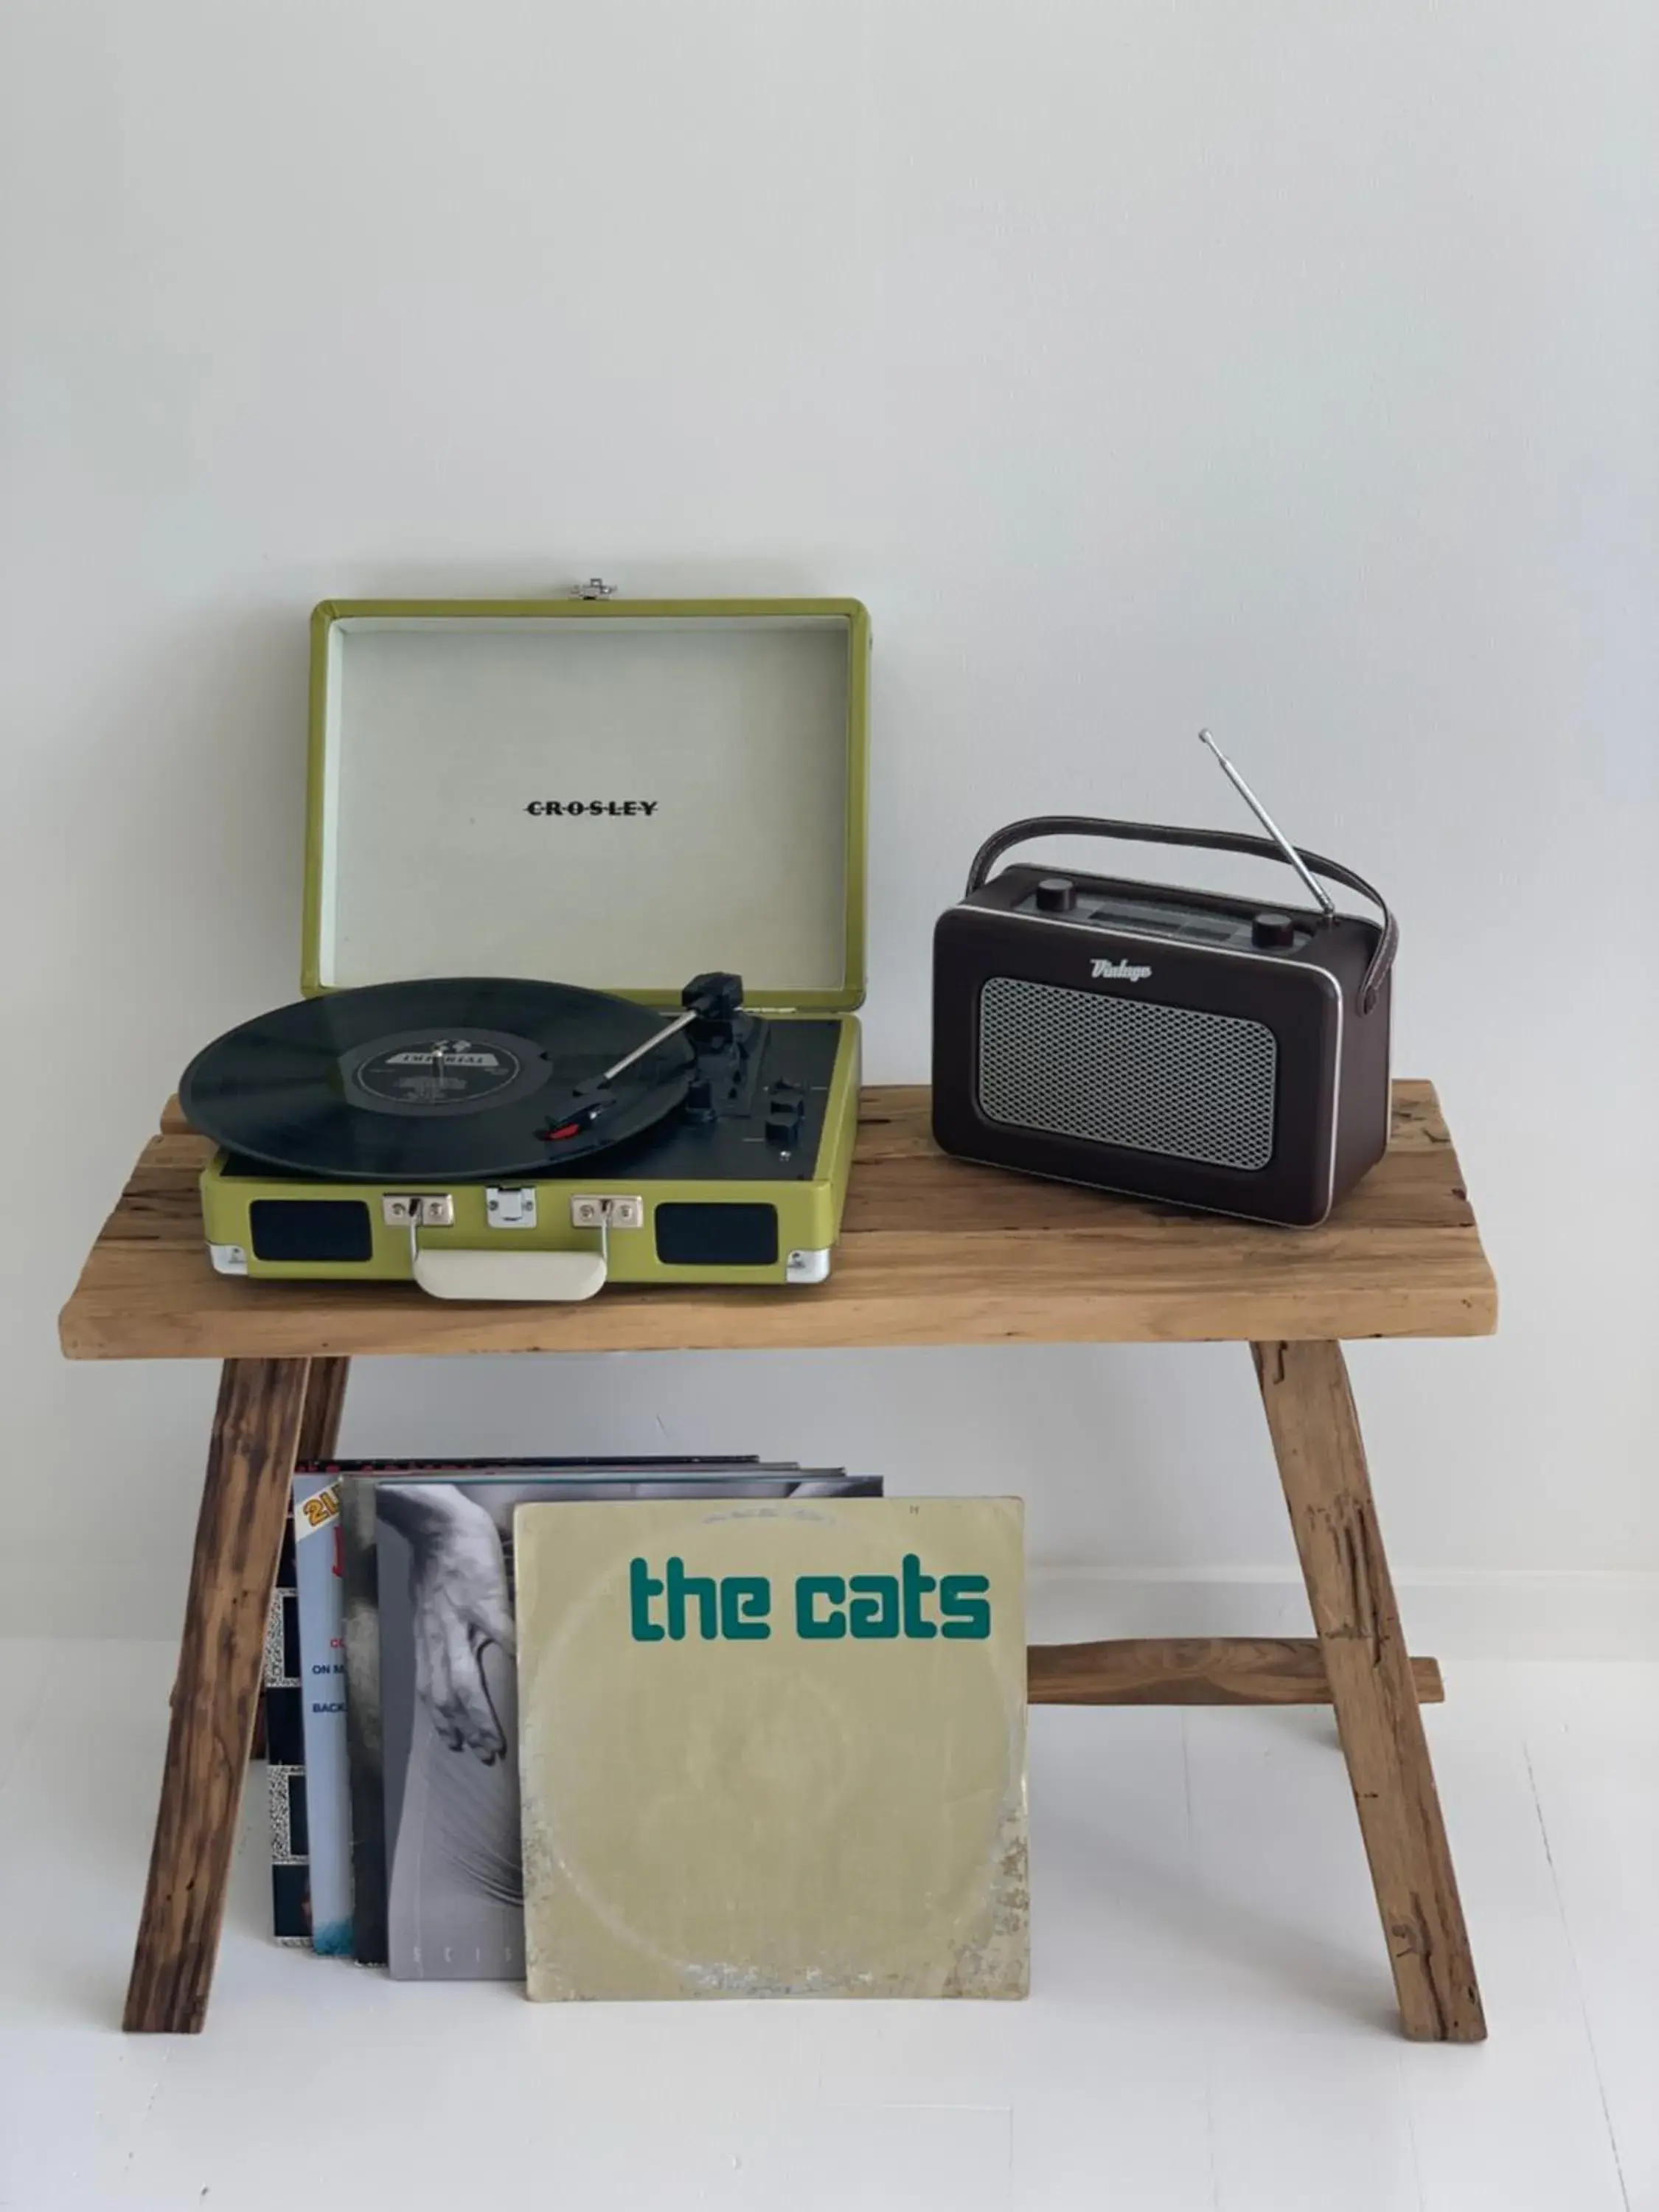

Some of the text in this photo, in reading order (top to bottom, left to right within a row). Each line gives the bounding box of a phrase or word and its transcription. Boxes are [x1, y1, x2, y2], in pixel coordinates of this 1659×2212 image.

[524, 800, 658, 816] CROSLEY
[1091, 959, 1152, 982] Vintage
[402, 1054, 484, 1064] IMPRIAL
[630, 1553, 992, 1642] the cats
[312, 1665, 330, 1674] ON
